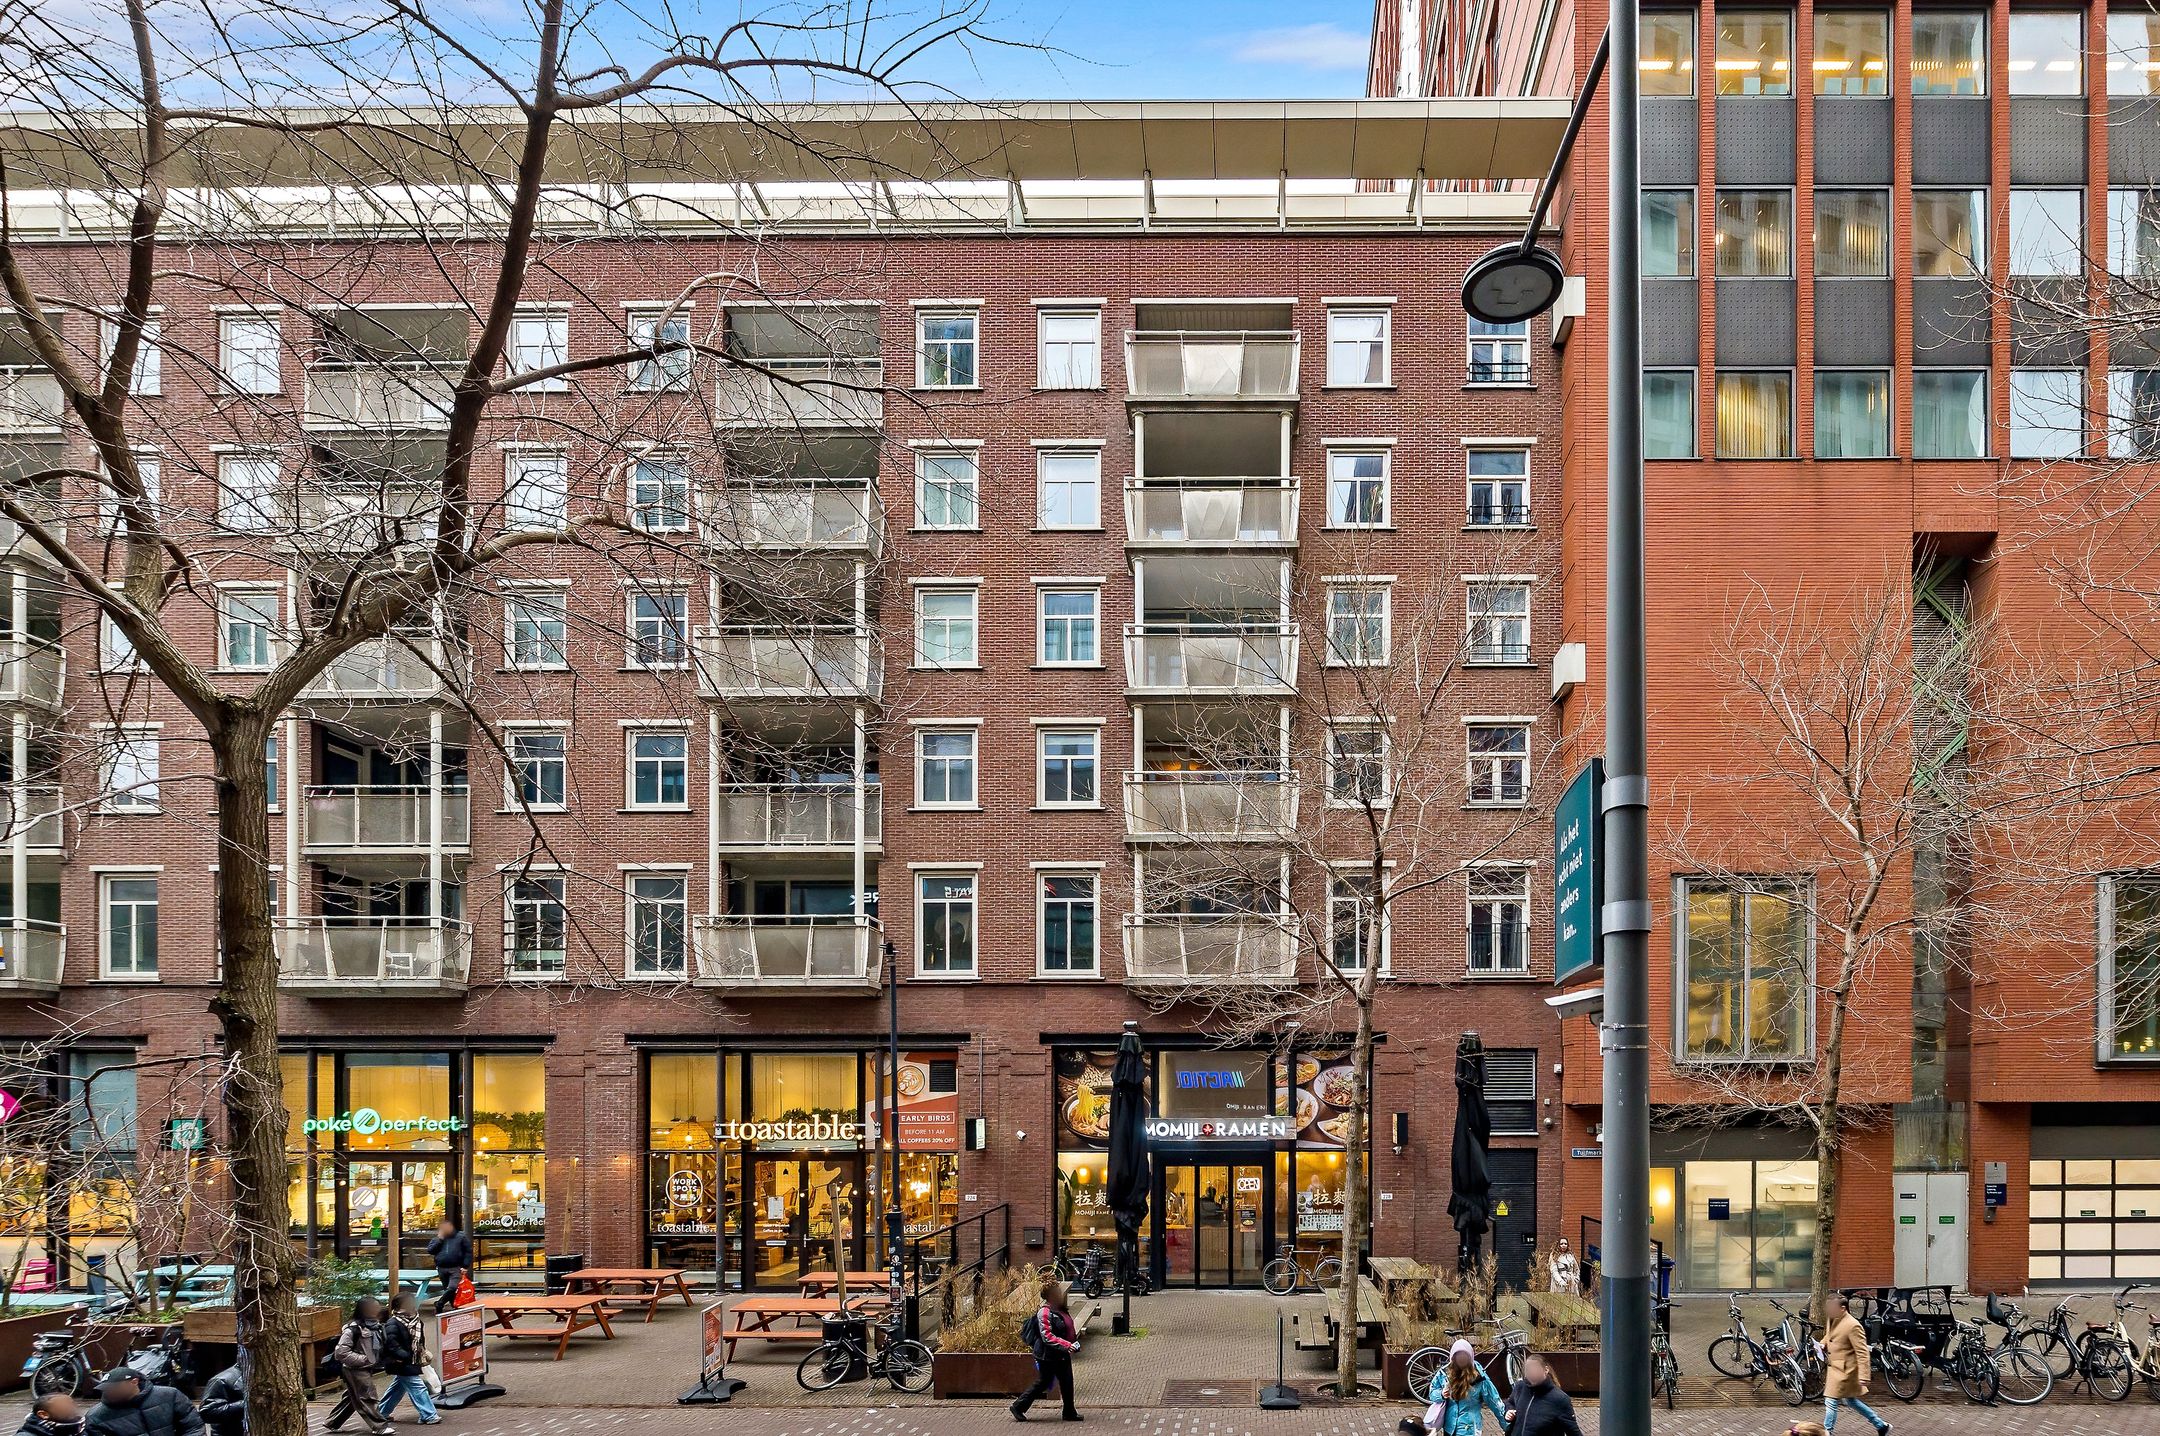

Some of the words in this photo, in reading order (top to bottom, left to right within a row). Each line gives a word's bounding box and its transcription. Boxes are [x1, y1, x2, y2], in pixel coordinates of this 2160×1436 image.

[1568, 818, 1579, 845] het
[303, 1111, 352, 1135] poké
[380, 1115, 462, 1135] perfect
[1145, 1122, 1199, 1140] MOMIJI
[1216, 1121, 1286, 1137] RAMEN
[1238, 1179, 1259, 1190] OPEN
